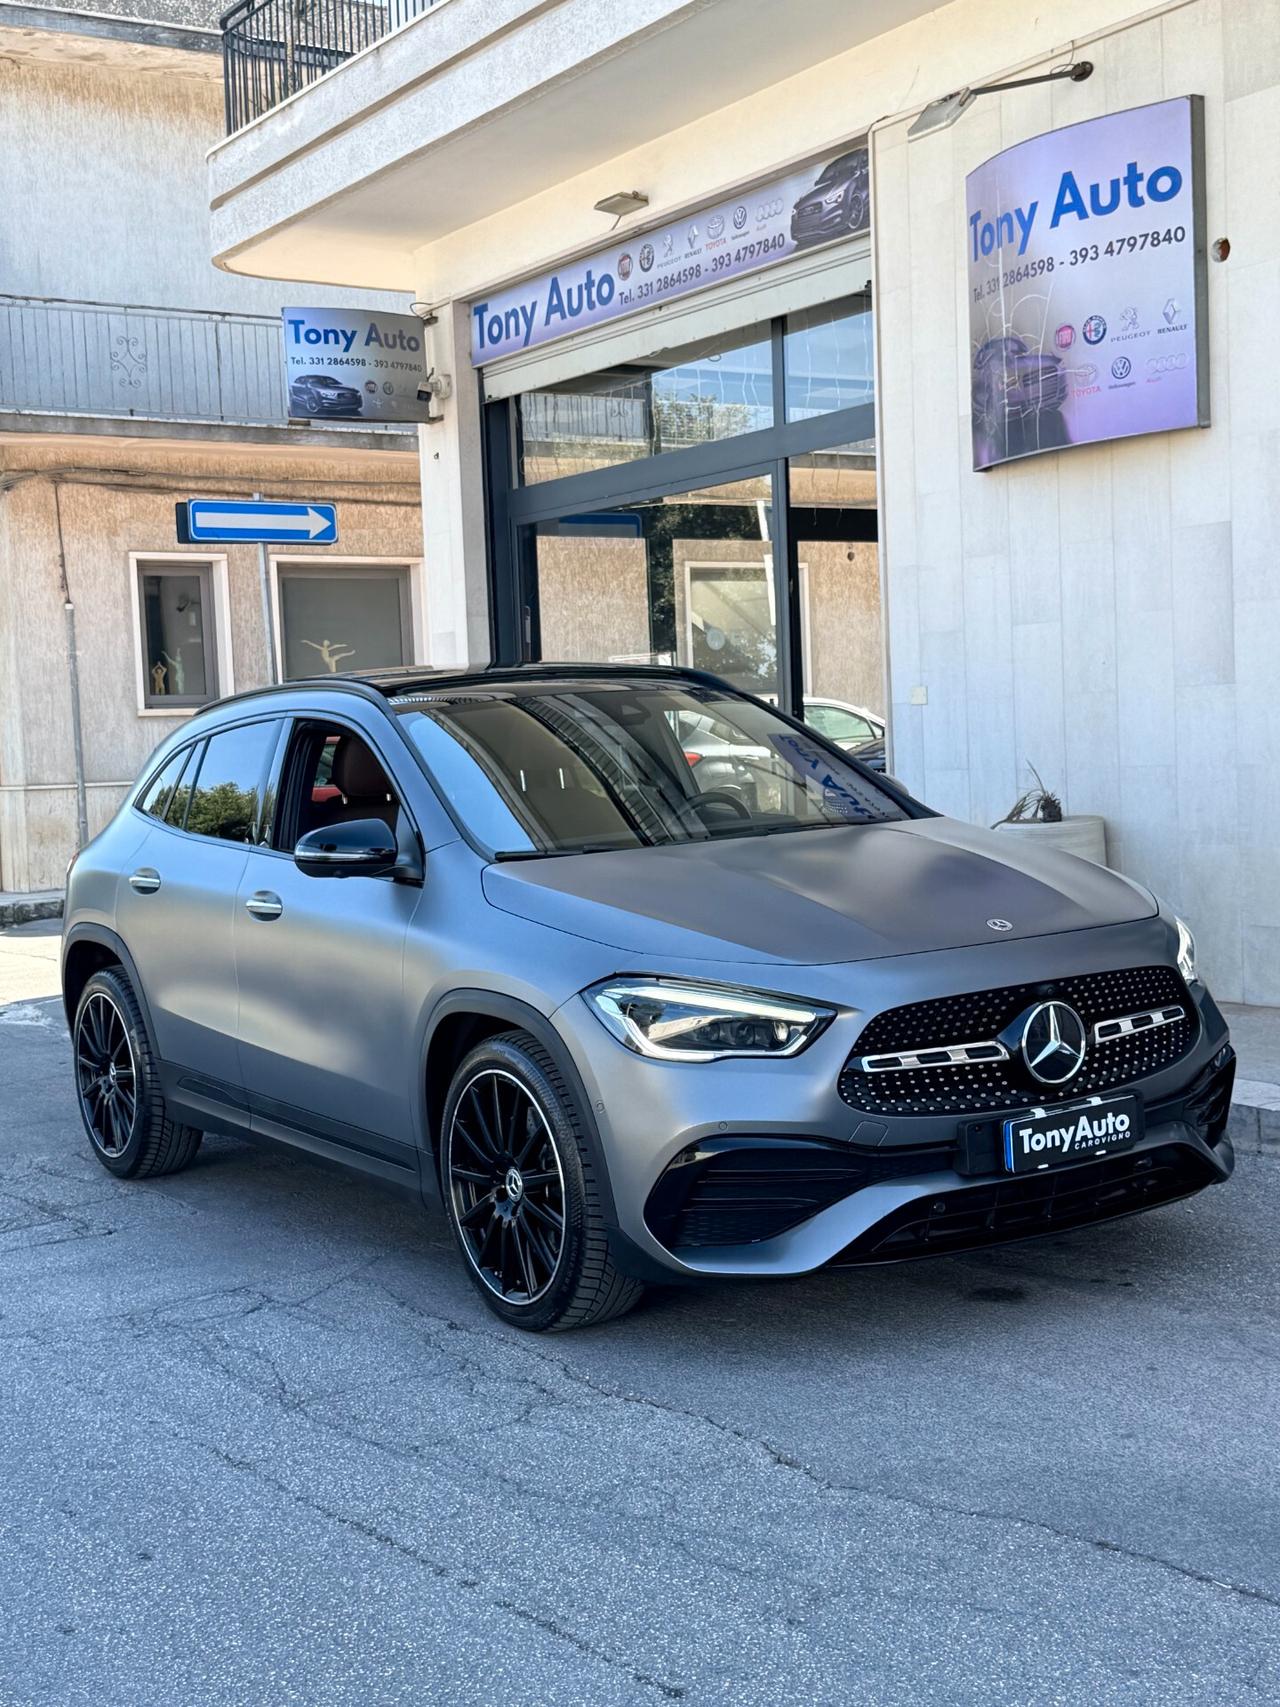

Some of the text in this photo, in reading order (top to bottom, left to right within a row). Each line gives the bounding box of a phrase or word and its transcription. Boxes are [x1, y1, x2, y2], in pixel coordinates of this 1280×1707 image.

[970, 161, 1183, 263] Tony Auto
[618, 291, 635, 306] Tel.
[637, 285, 654, 300] 331
[656, 264, 702, 293] 2864598
[711, 253, 732, 273] 393
[734, 233, 785, 263] 4797840
[1002, 256, 1055, 288] 2864598
[1069, 247, 1100, 267] 393
[1104, 226, 1187, 257] 4797840
[473, 270, 615, 349] Tony Auto
[288, 319, 420, 353] Tony Auto
[1110, 330, 1152, 343] PEUGEOT
[291, 356, 307, 366] Tel.
[309, 357, 325, 366] 331
[326, 357, 367, 367] 2864598
[374, 359, 389, 369] 393
[390, 361, 423, 373] 4797840
[1019, 1112, 1130, 1154] TonyAuto
[1074, 1130, 1131, 1150] CAROVIGNO
